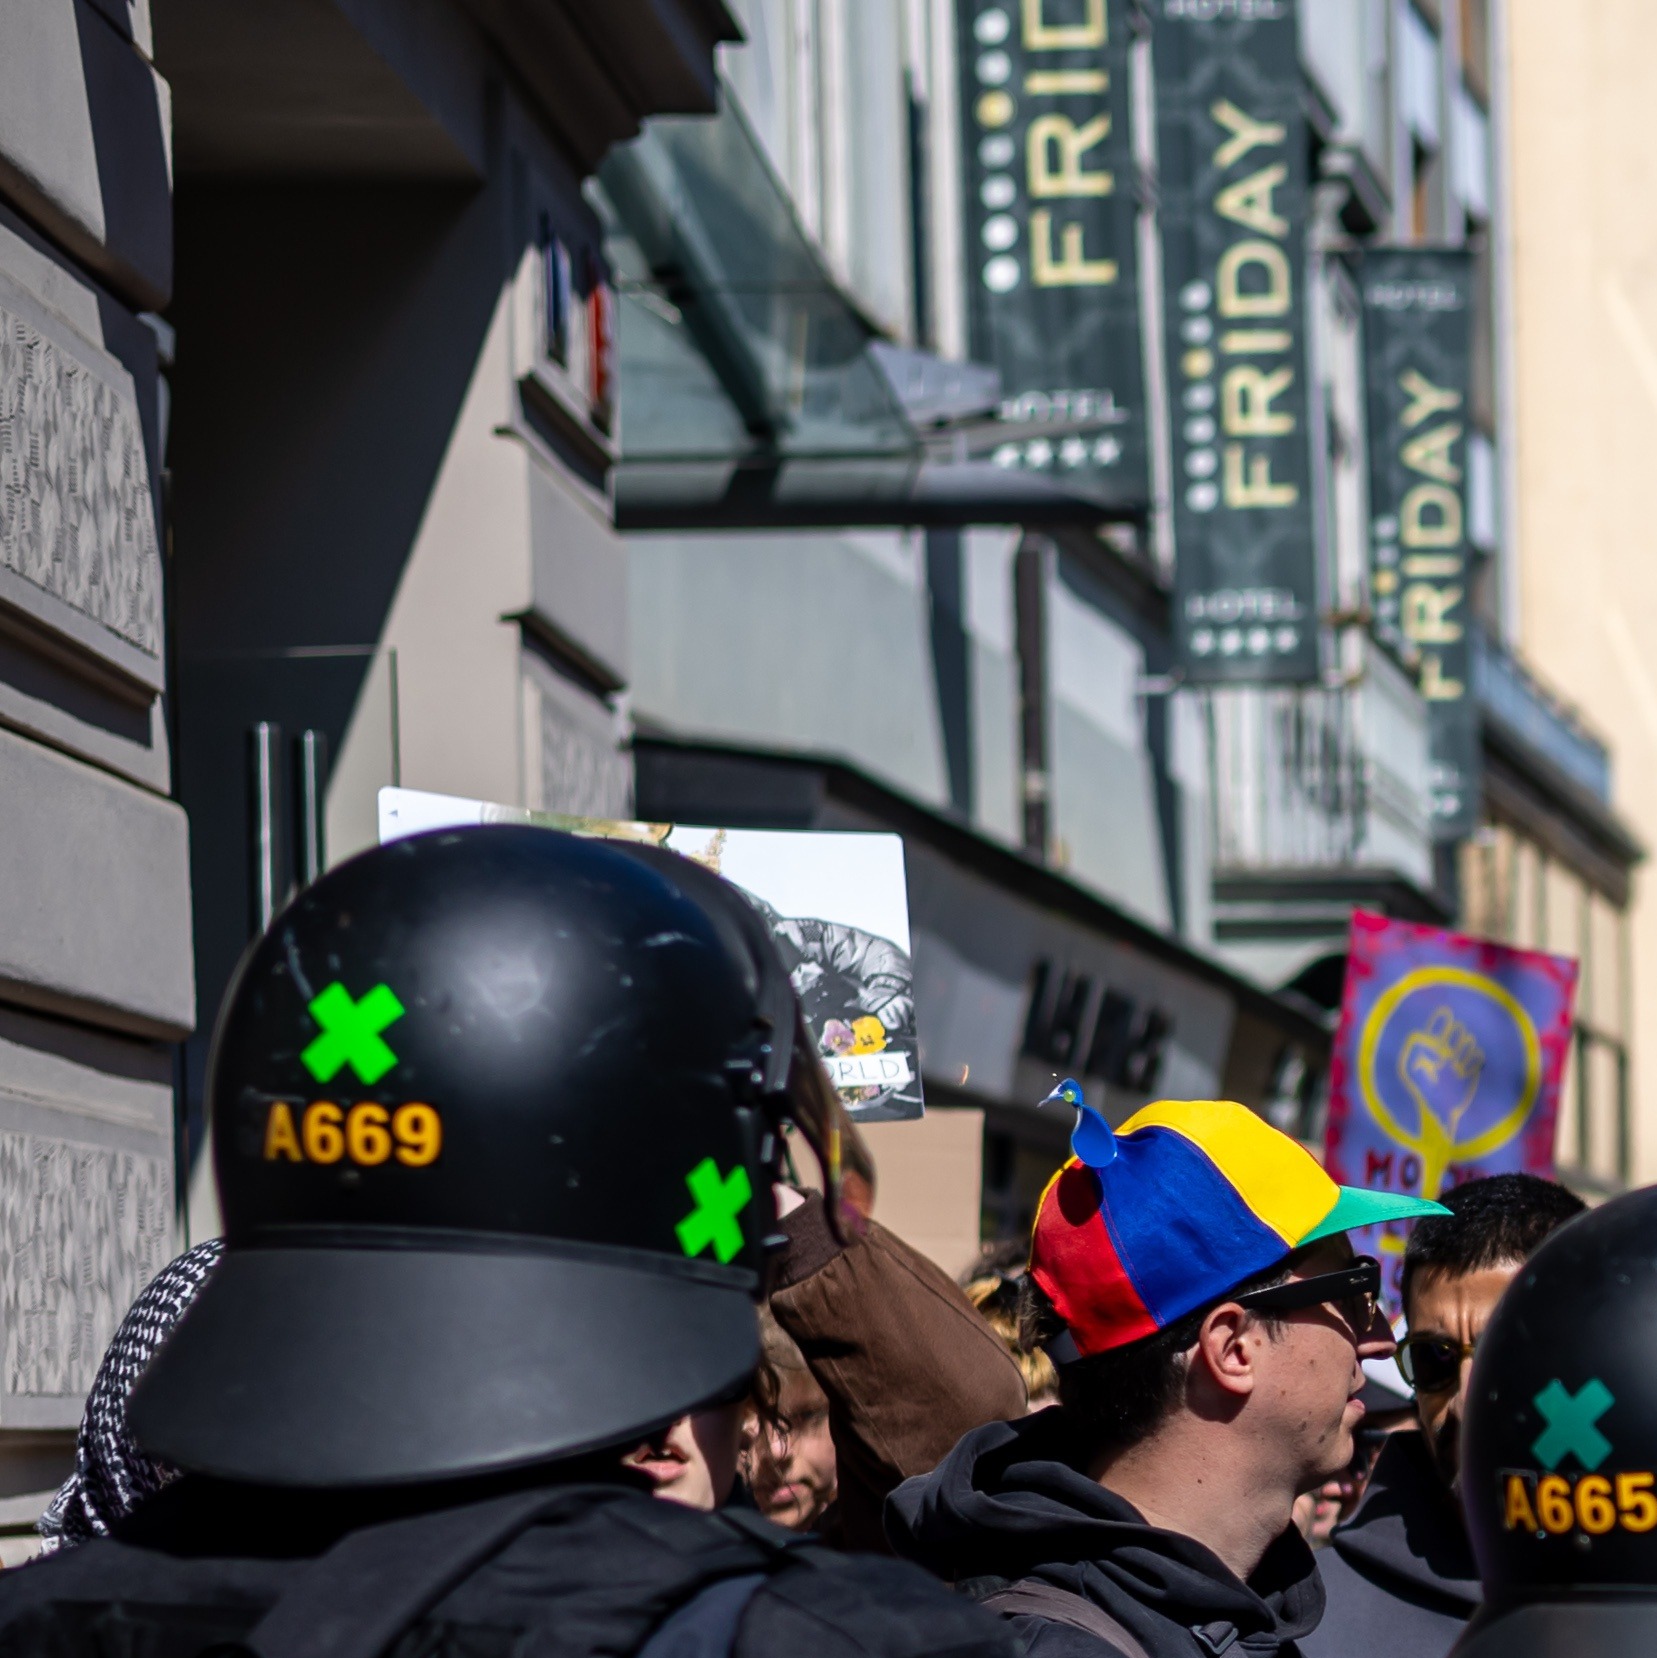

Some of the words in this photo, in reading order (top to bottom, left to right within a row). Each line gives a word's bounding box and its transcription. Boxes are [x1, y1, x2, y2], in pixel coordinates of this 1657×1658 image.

[1208, 97, 1299, 510] FRIDAY
[1400, 368, 1464, 702] FRIDAY
[262, 1100, 443, 1168] A669
